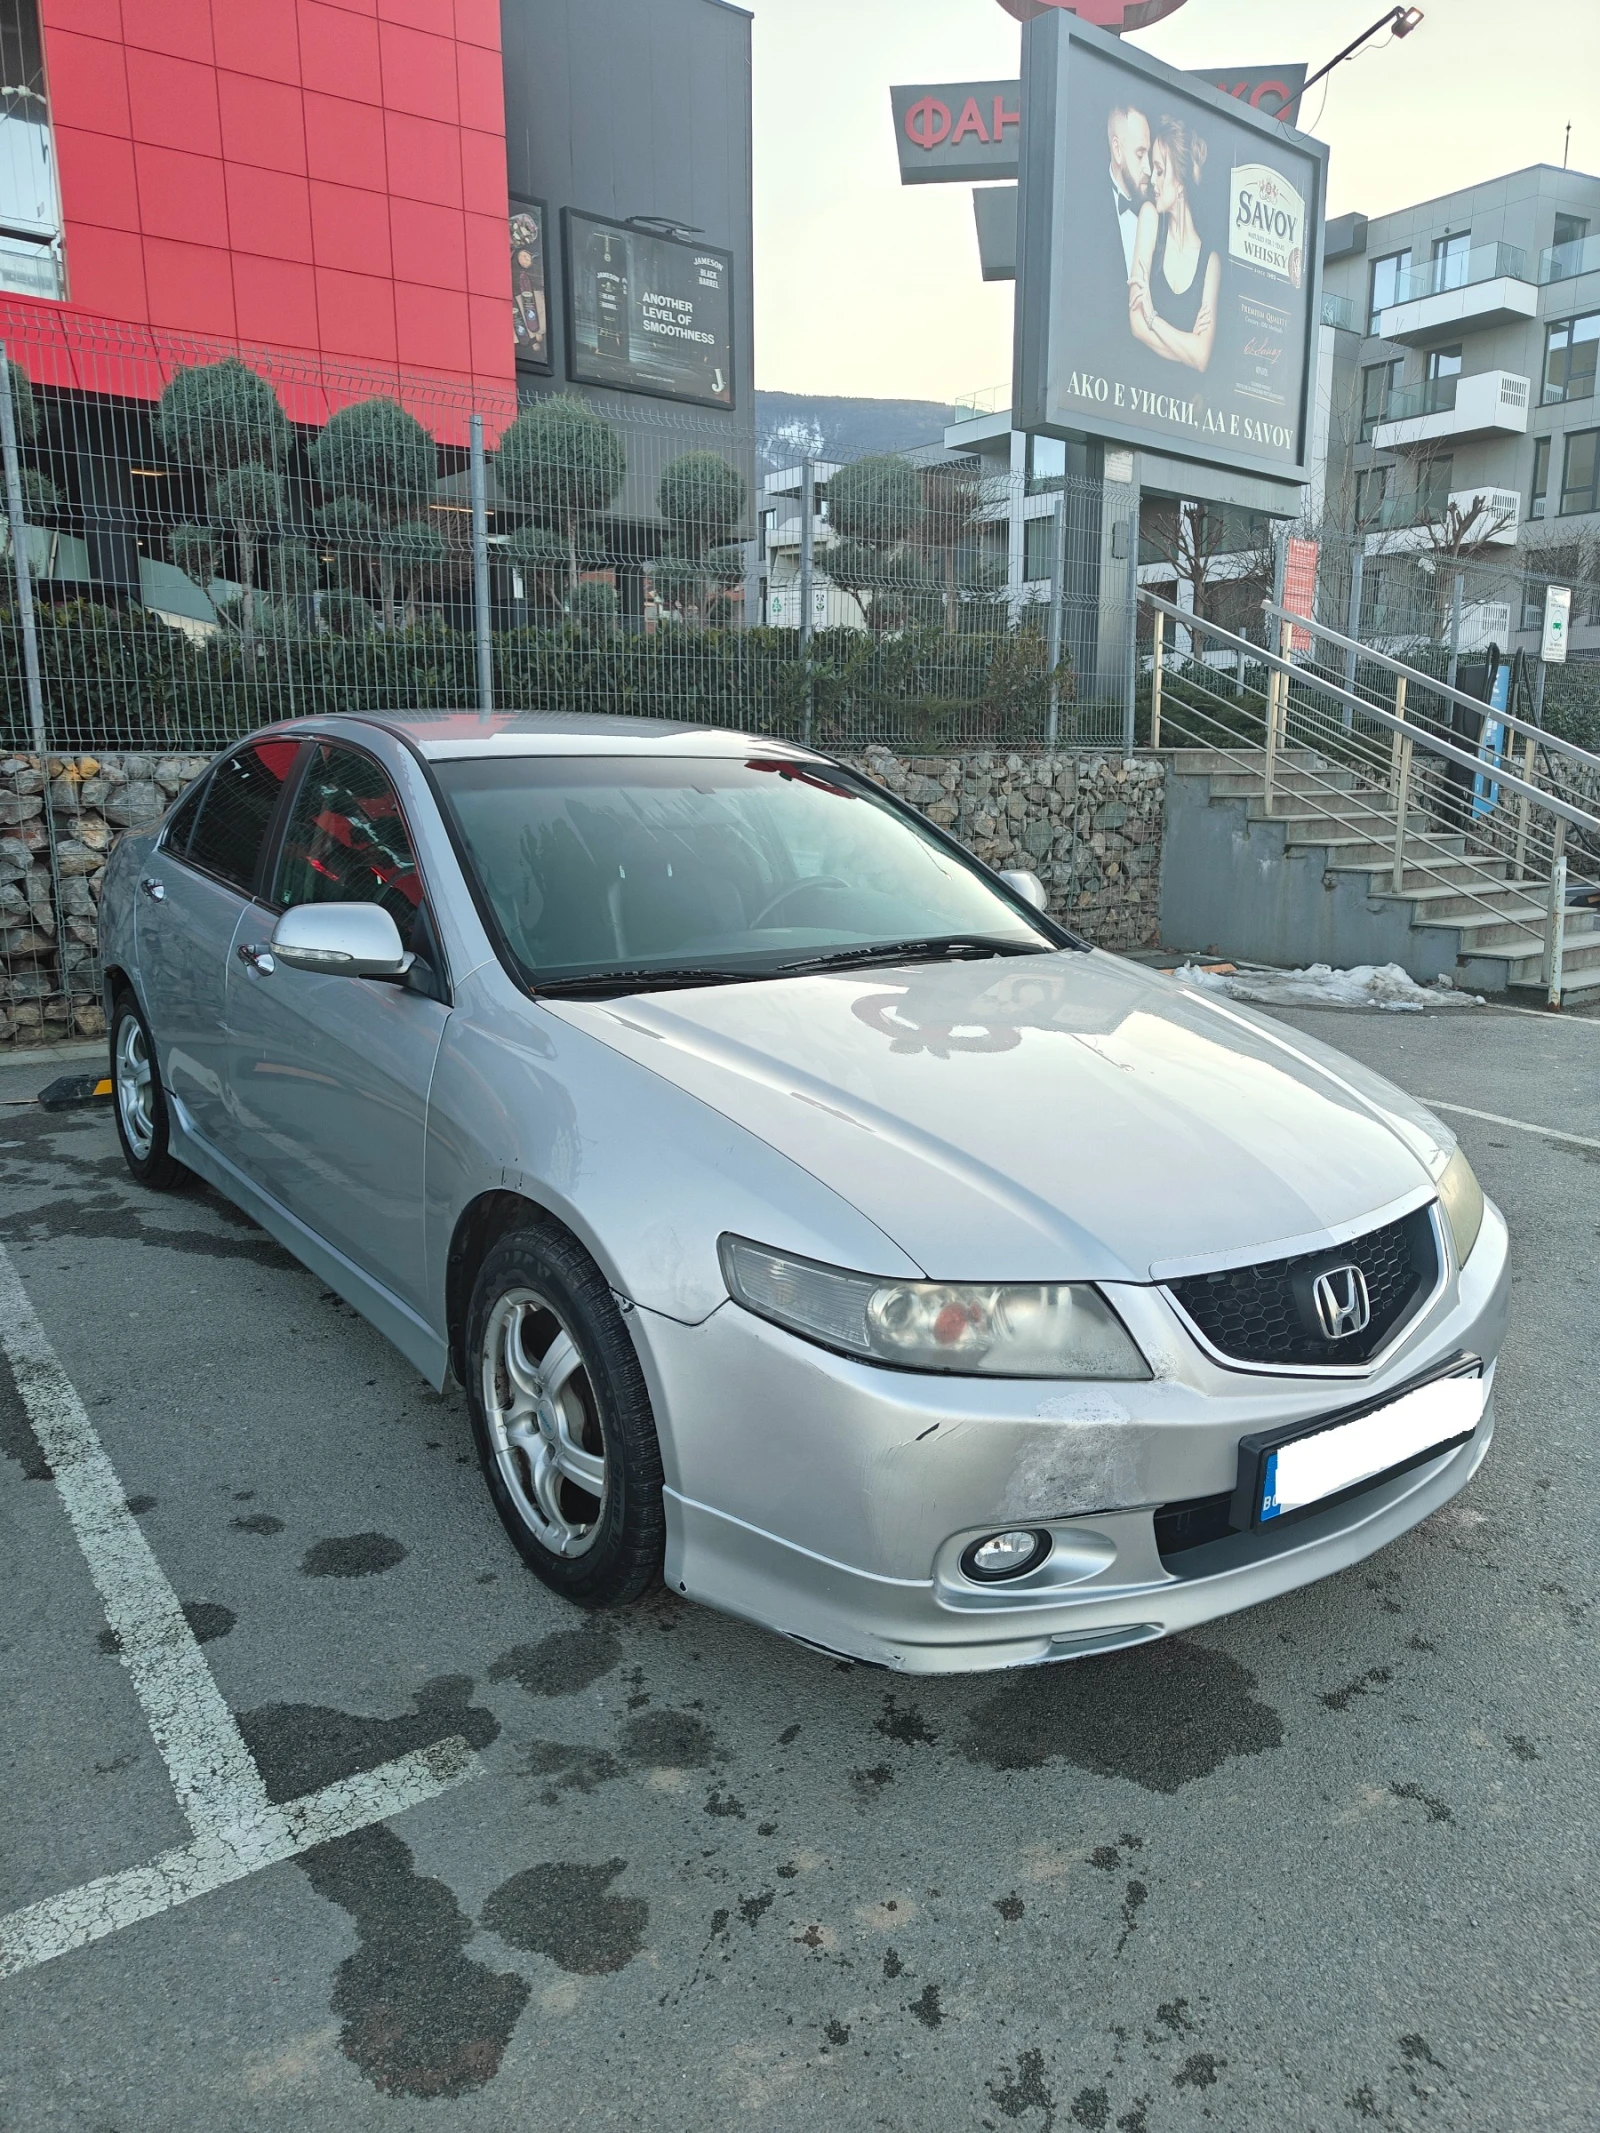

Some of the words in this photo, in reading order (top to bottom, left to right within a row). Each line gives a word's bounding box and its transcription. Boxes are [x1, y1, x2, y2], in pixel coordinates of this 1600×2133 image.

[1236, 190, 1297, 244] SAVOY
[693, 256, 724, 271] JAMESON
[1243, 240, 1288, 269] WHISKY
[698, 276, 720, 289] BARREL
[700, 268, 717, 280] BLACK
[642, 292, 693, 313] ANOTHER
[642, 305, 676, 323] LEVEL
[677, 314, 693, 326] OF
[642, 319, 715, 345] SMOOTHNESS
[1066, 371, 1109, 402] АКО
[1113, 382, 1126, 407] Е
[1130, 386, 1198, 429] УИСКИ,
[1202, 408, 1226, 435] ДА
[1230, 413, 1240, 437] Е
[1243, 417, 1294, 449] SAVOY
